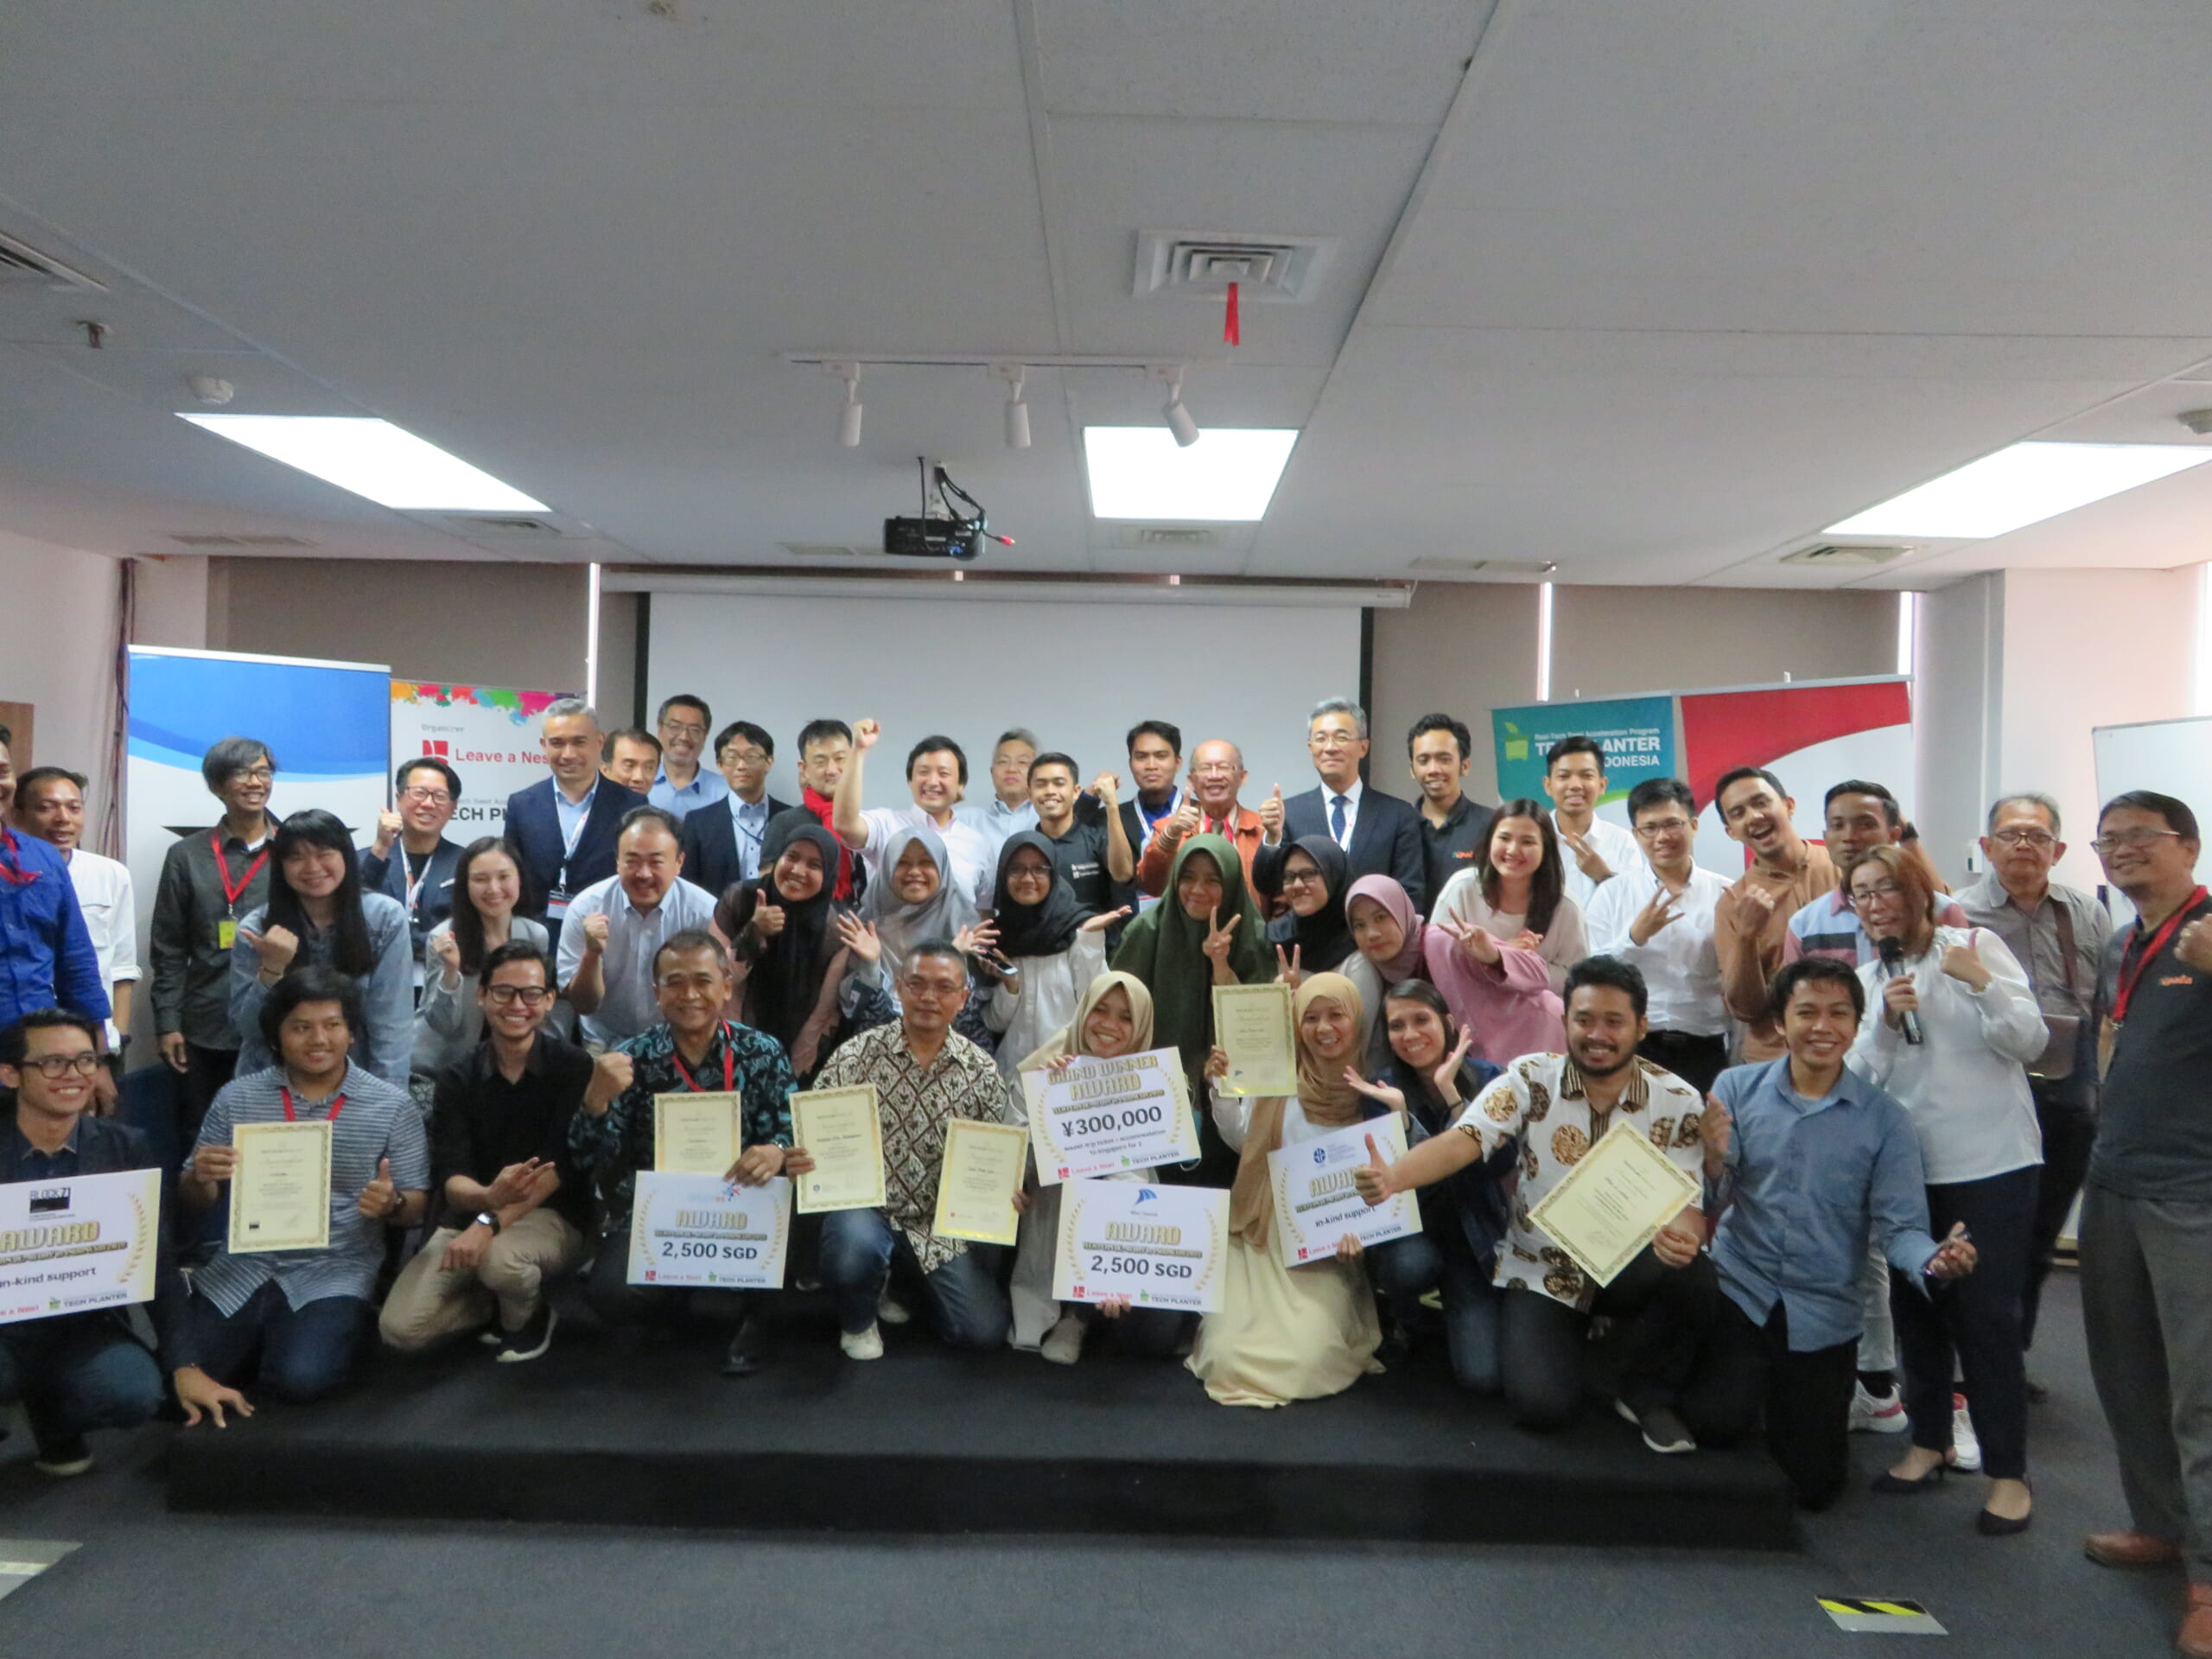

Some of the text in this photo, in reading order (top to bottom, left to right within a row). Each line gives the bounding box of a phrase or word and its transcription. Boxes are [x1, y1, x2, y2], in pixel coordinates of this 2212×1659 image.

[1602, 736, 1661, 753] ANTER
[455, 747, 548, 764] Leave a Nes
[1604, 754, 1660, 768] DONESIA
[1100, 1055, 1159, 1077] WINNER
[1070, 1073, 1141, 1101] AWARD
[1062, 1106, 1161, 1137] ¥300,000
[676, 1211, 748, 1230] AWARD
[0, 1221, 100, 1252] AWARD
[1105, 1222, 1181, 1245] AWARD
[662, 1242, 758, 1260] 2,500 SGD
[47, 1267, 96, 1281] support
[1090, 1255, 1192, 1279] 2,500 SGD
